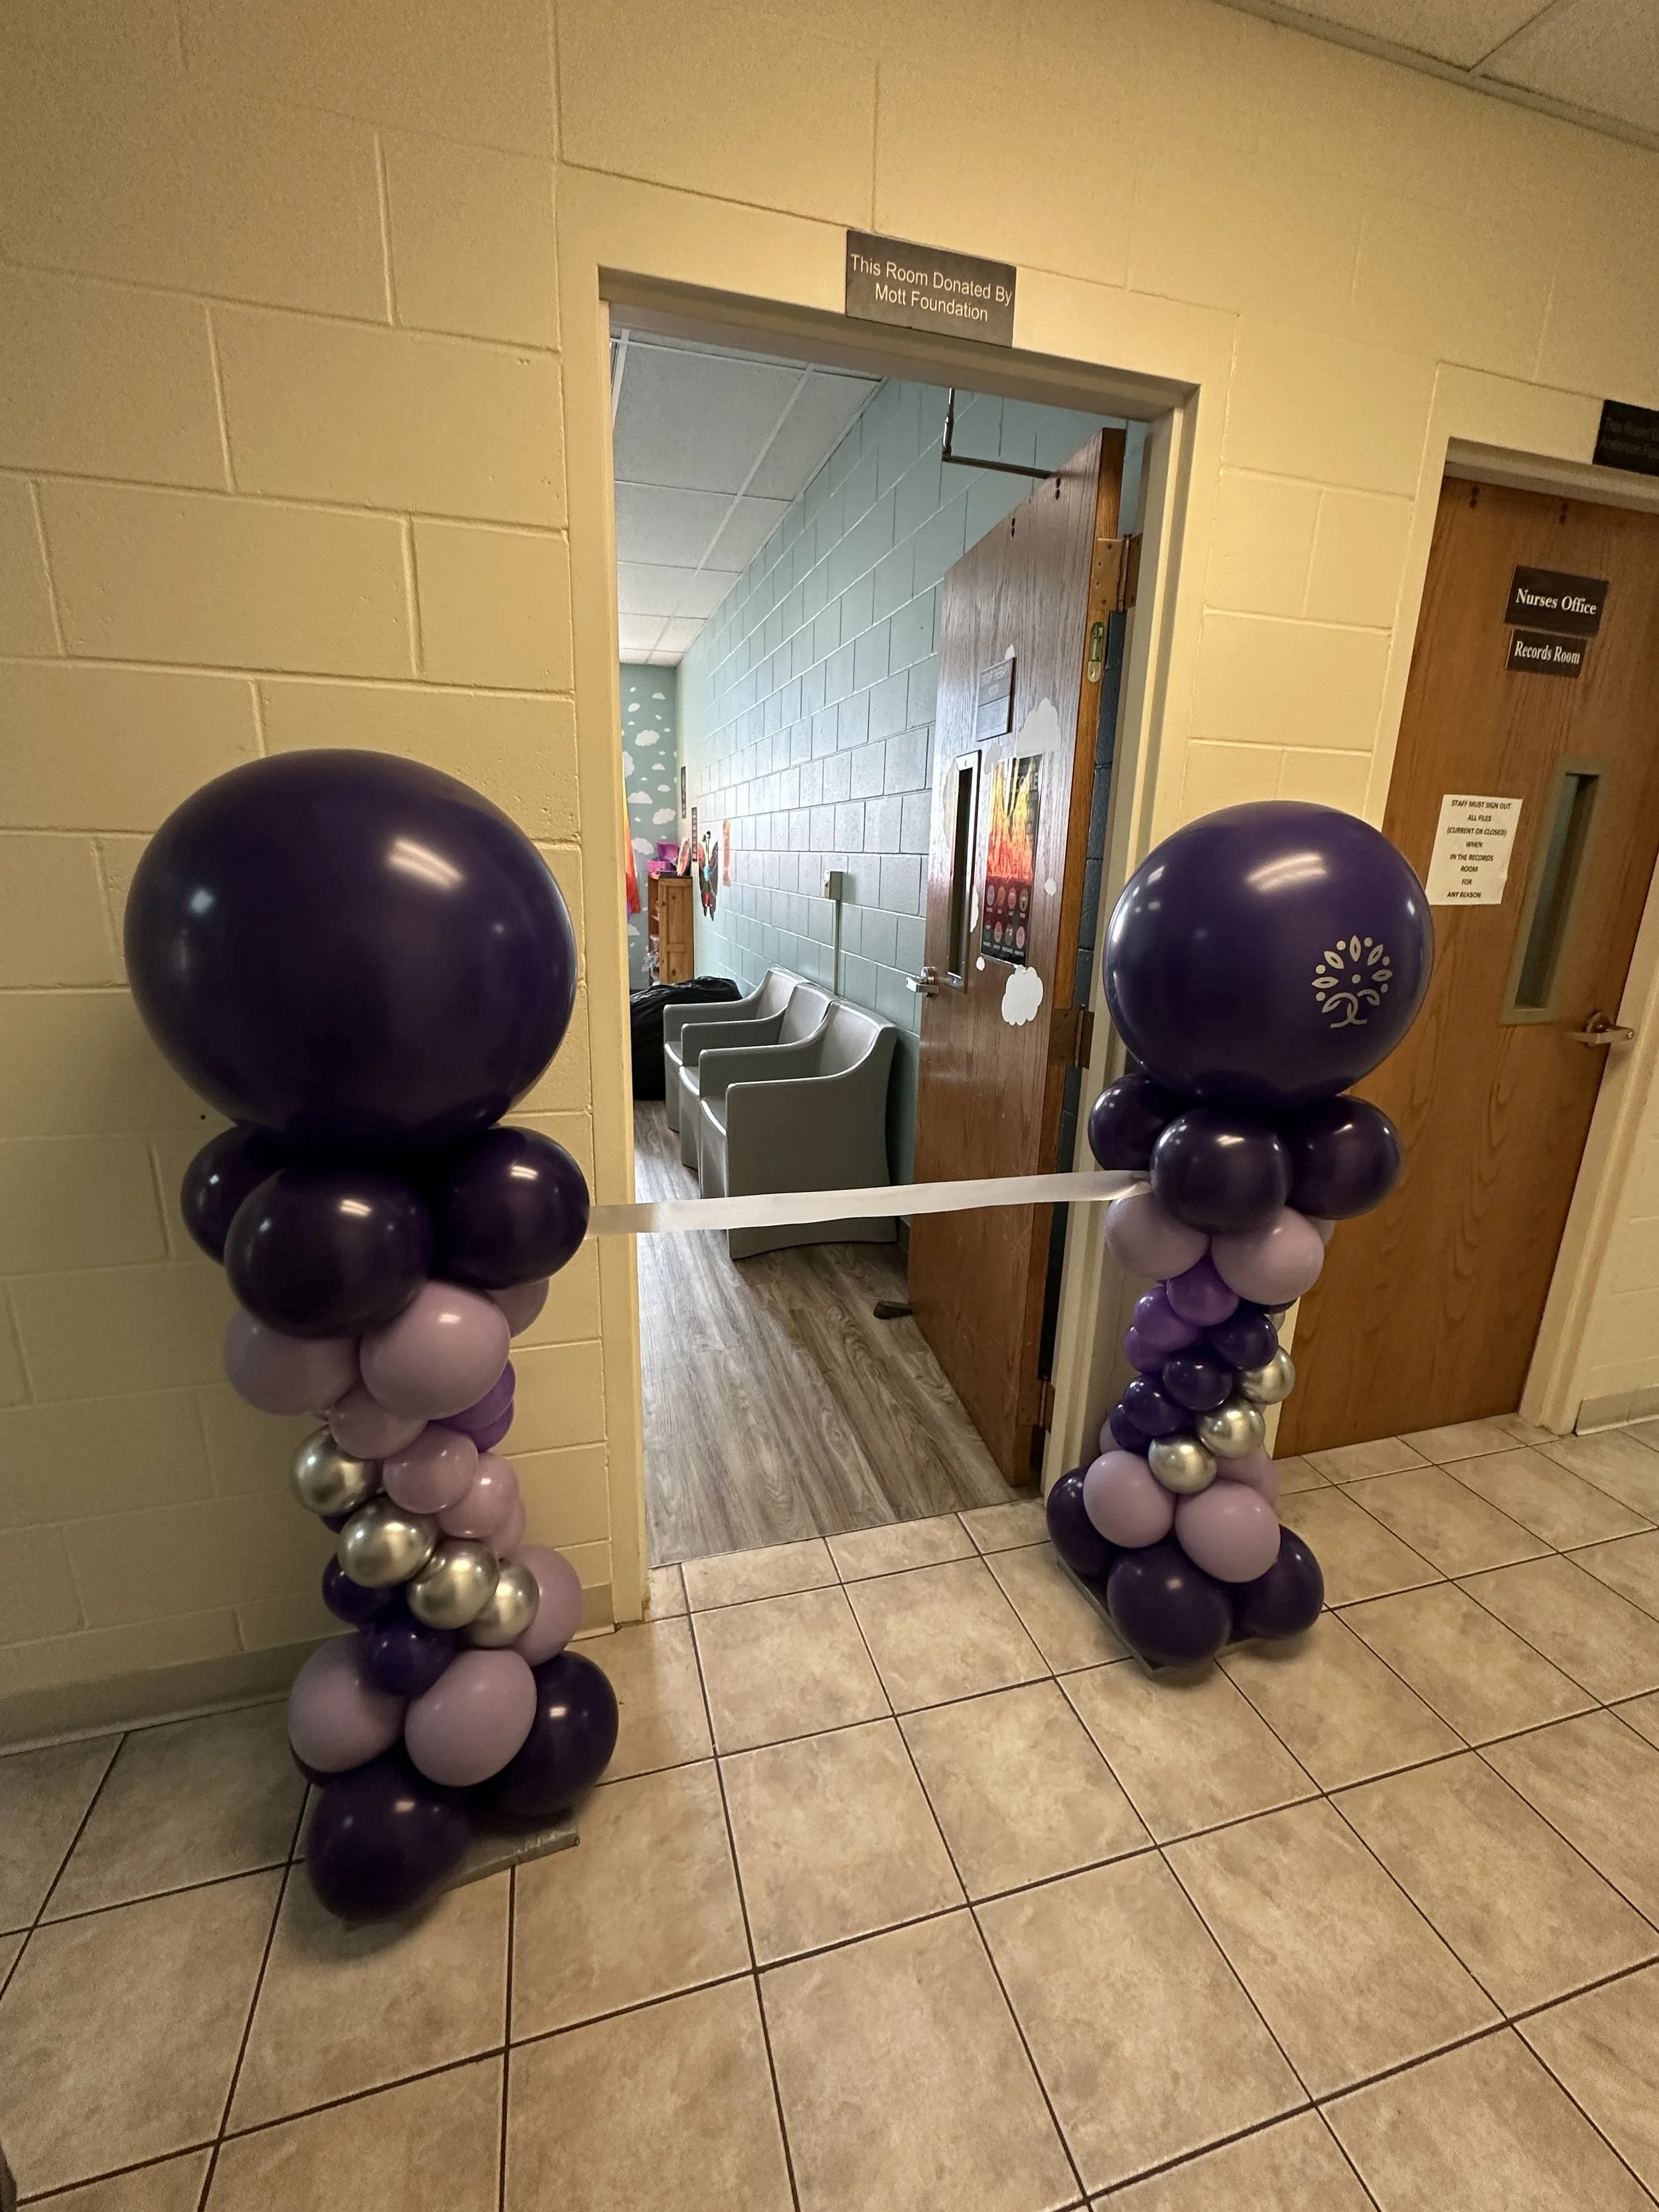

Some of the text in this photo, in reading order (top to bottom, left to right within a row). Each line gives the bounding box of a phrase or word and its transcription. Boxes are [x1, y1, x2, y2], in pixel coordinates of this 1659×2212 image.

[850, 254, 1013, 307] This Room Donated By
[875, 283, 988, 322] Mott Foundation
[1516, 588, 1597, 615] Nurses Office
[1514, 640, 1581, 664] Records Room
